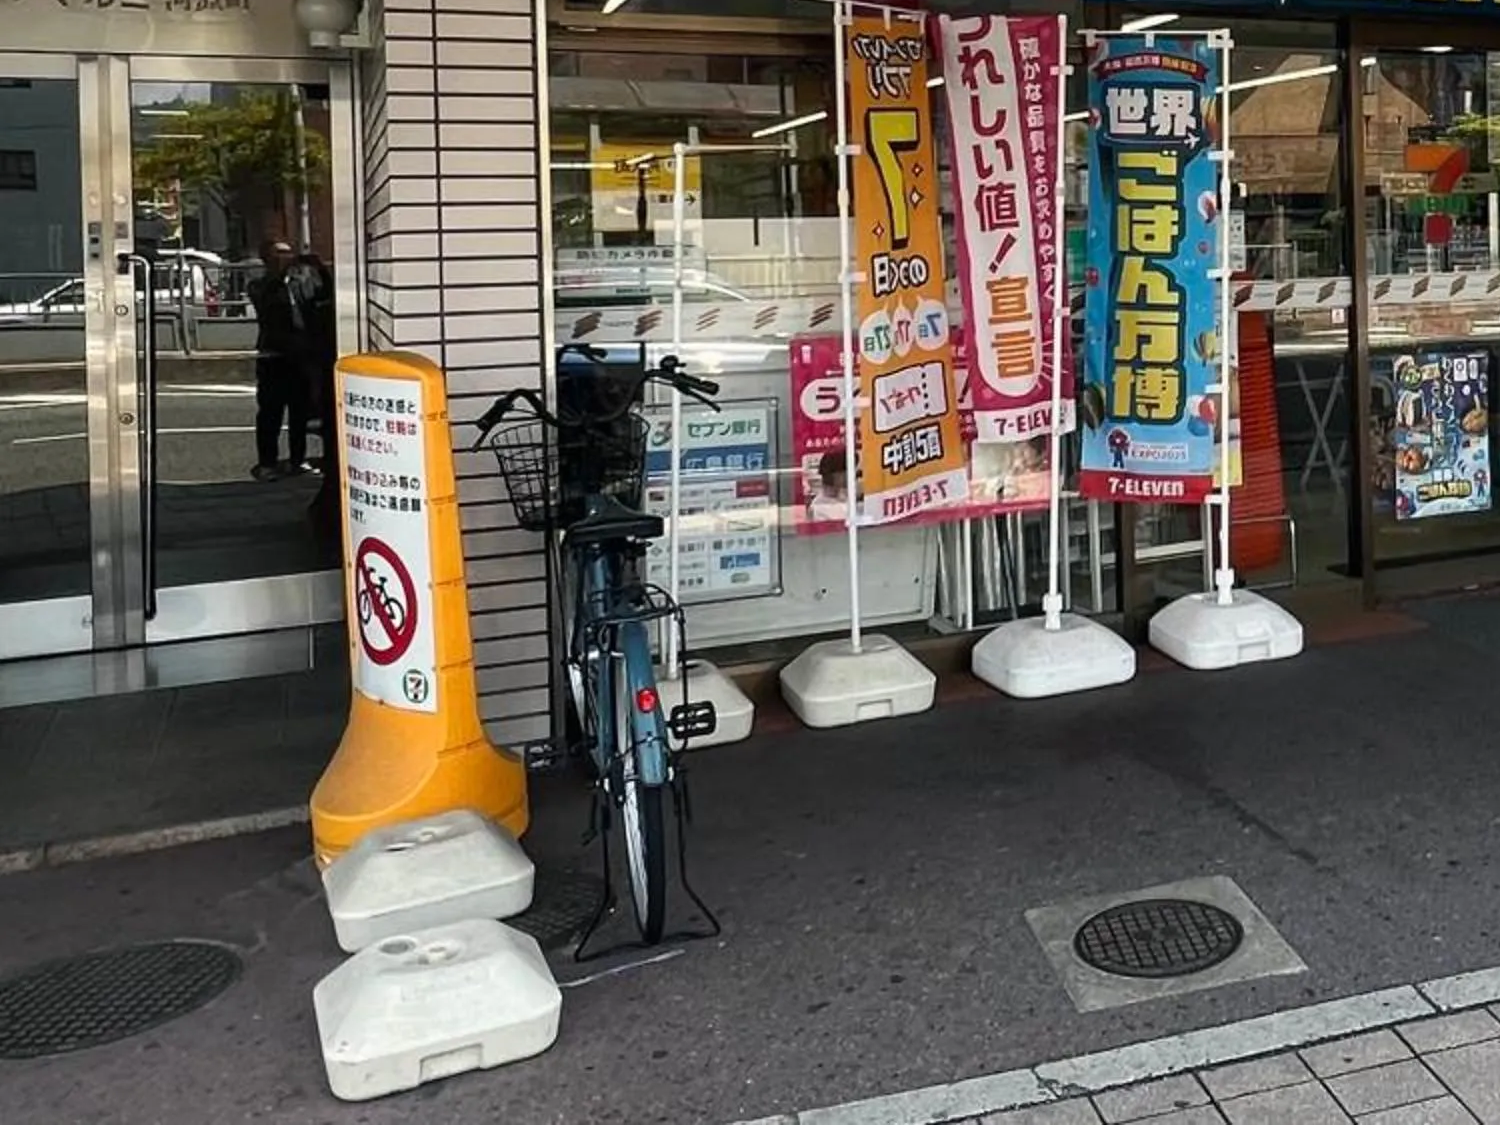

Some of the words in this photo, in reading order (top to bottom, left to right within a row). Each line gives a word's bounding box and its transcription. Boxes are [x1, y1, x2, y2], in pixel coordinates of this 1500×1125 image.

[1105, 87, 1197, 136] 世界
[1112, 150, 1180, 420] ごはん万博
